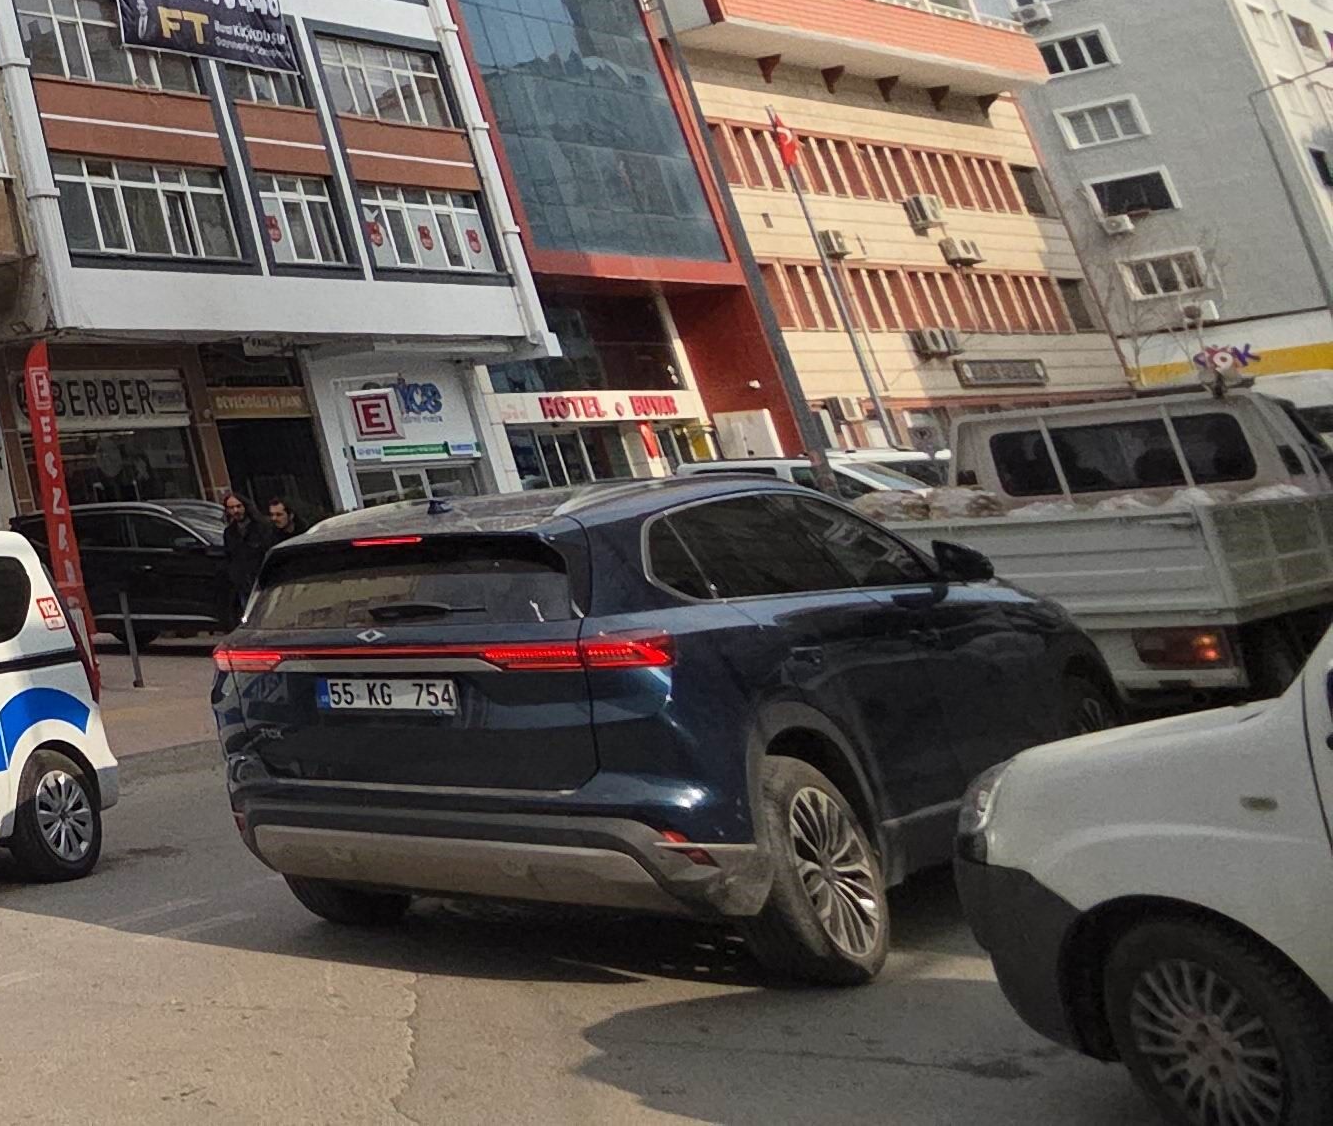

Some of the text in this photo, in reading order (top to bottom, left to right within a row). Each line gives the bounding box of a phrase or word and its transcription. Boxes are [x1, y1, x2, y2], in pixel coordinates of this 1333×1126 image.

[156, 5, 210, 45] FT
[52, 379, 155, 415] BERBER
[538, 396, 607, 419] HOTEL
[629, 395, 678, 417] BUYAR
[361, 403, 385, 428] E
[330, 682, 455, 707] 55 KG 754
